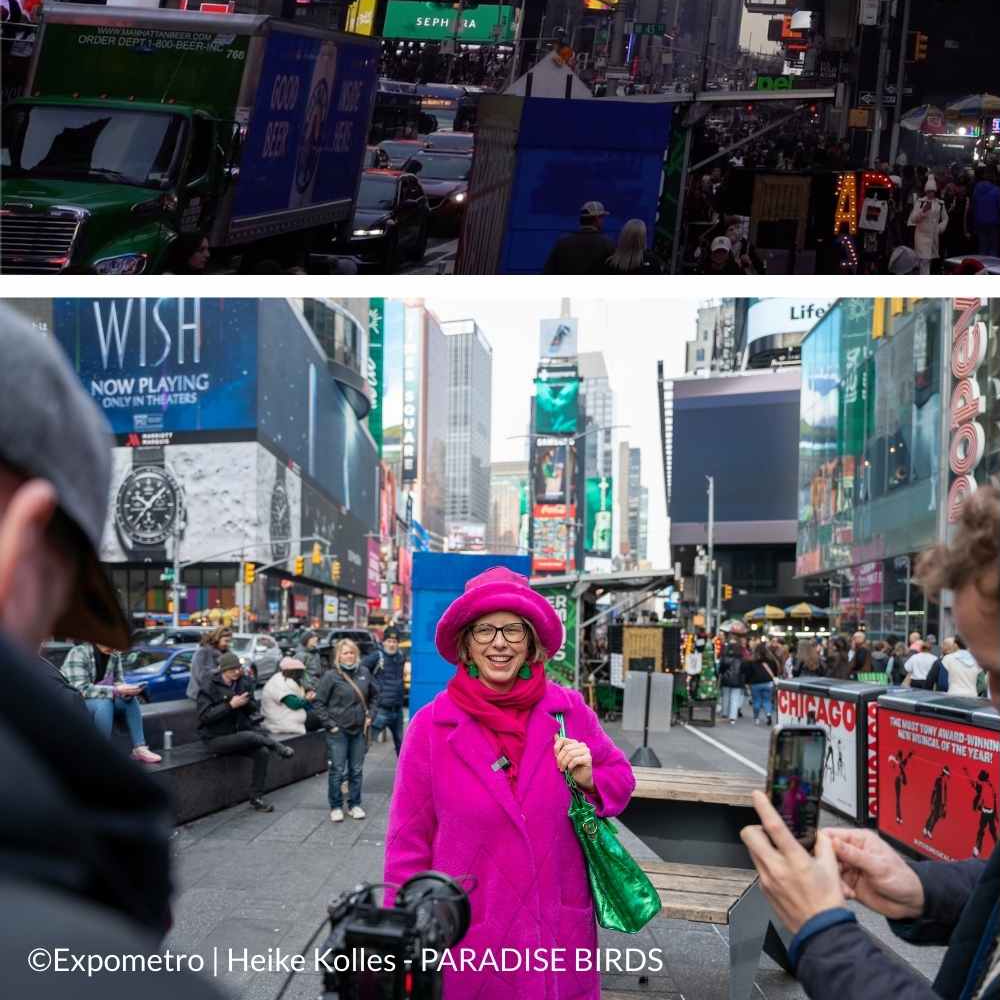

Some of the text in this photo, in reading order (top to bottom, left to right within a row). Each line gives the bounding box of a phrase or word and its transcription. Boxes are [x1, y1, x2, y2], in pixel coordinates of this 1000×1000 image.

[416, 16, 477, 29] SEPHRA
[77, 34, 117, 46] ORDER
[94, 298, 201, 369] WISH
[91, 373, 210, 396] NOW PLAYING
[102, 391, 198, 408] ONLY IN THEATERS
[777, 688, 857, 732] CHICAGO
[920, 723, 937, 737] TONY
[938, 727, 1000, 752] AWARD-WINNIN
[941, 740, 951, 751] OF
[952, 743, 967, 756] THE
[968, 746, 993, 764] YEAR!
